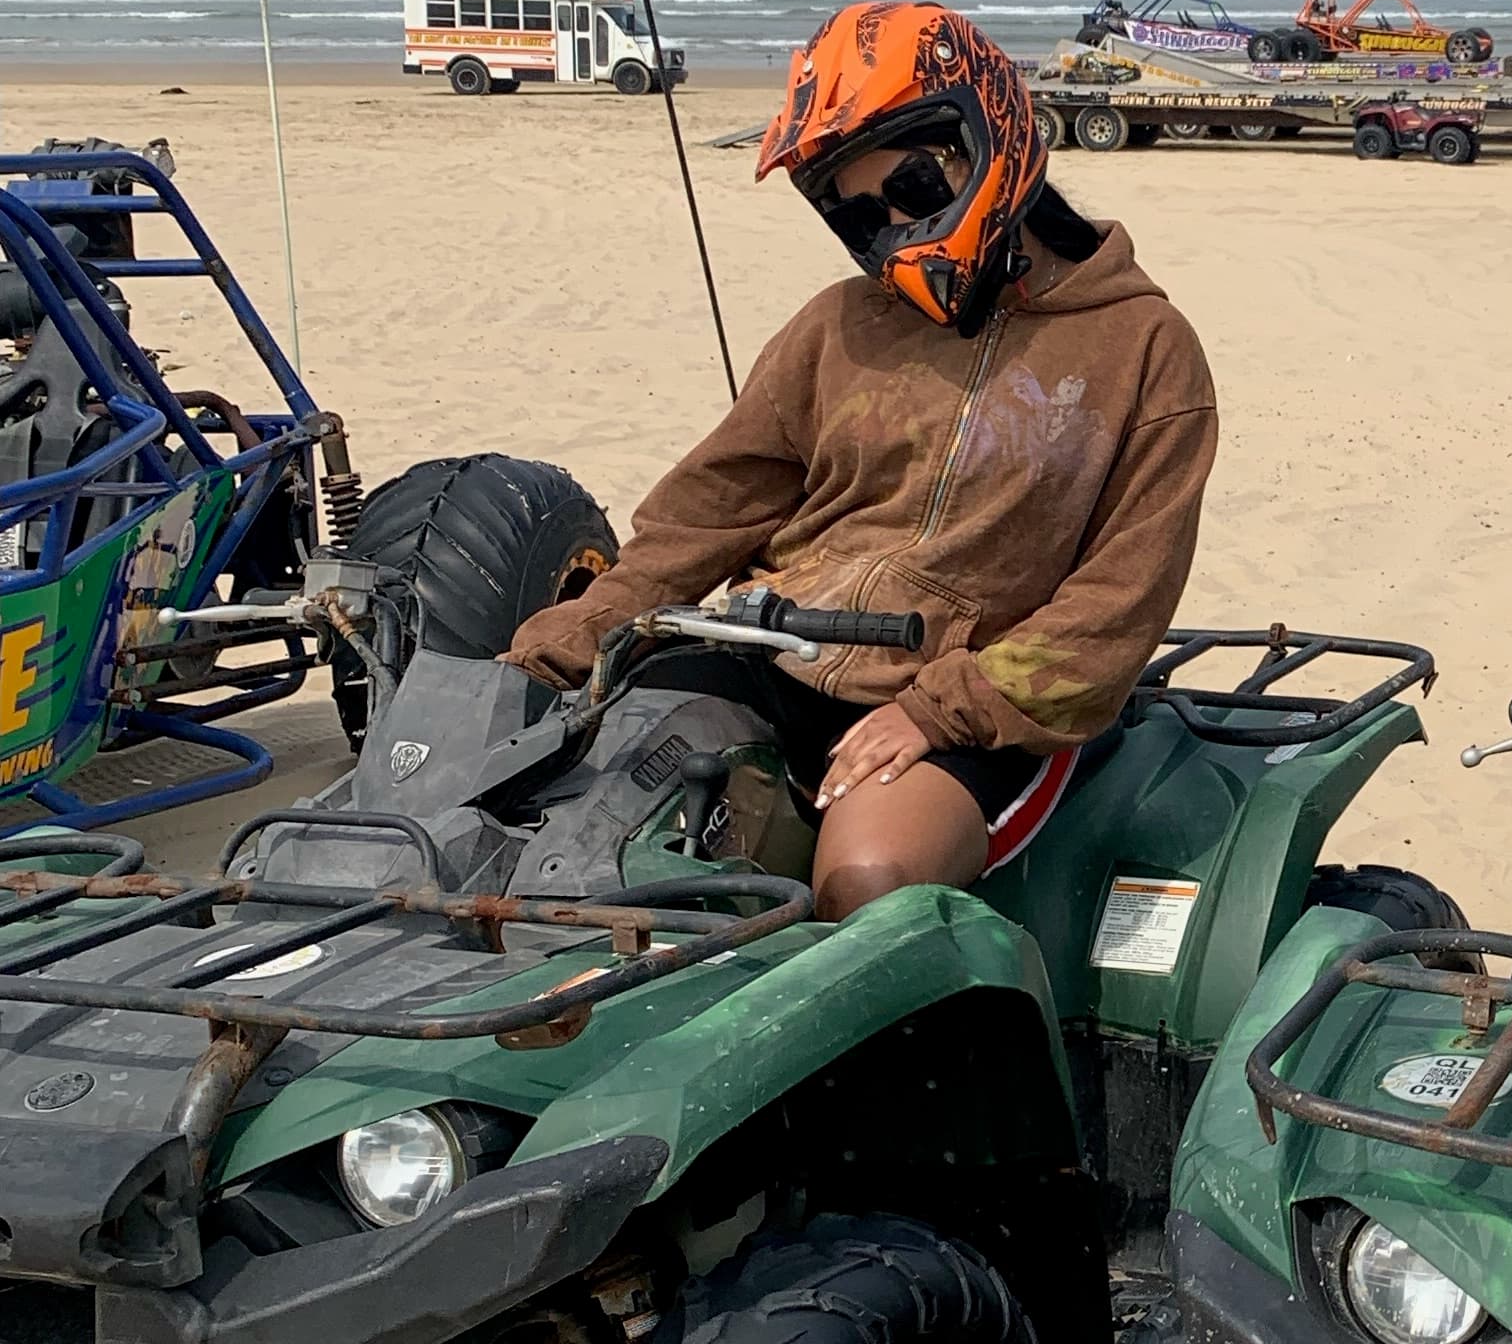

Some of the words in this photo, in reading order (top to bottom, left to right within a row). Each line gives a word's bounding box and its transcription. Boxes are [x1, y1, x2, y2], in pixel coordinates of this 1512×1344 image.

[1110, 96, 1150, 106] WHERE
[1153, 96, 1175, 106] THE
[1178, 96, 1202, 106] FUN
[1205, 97, 1242, 107] NEVER
[634, 737, 687, 788] YAMAHA
[1435, 1058, 1475, 1070] QL
